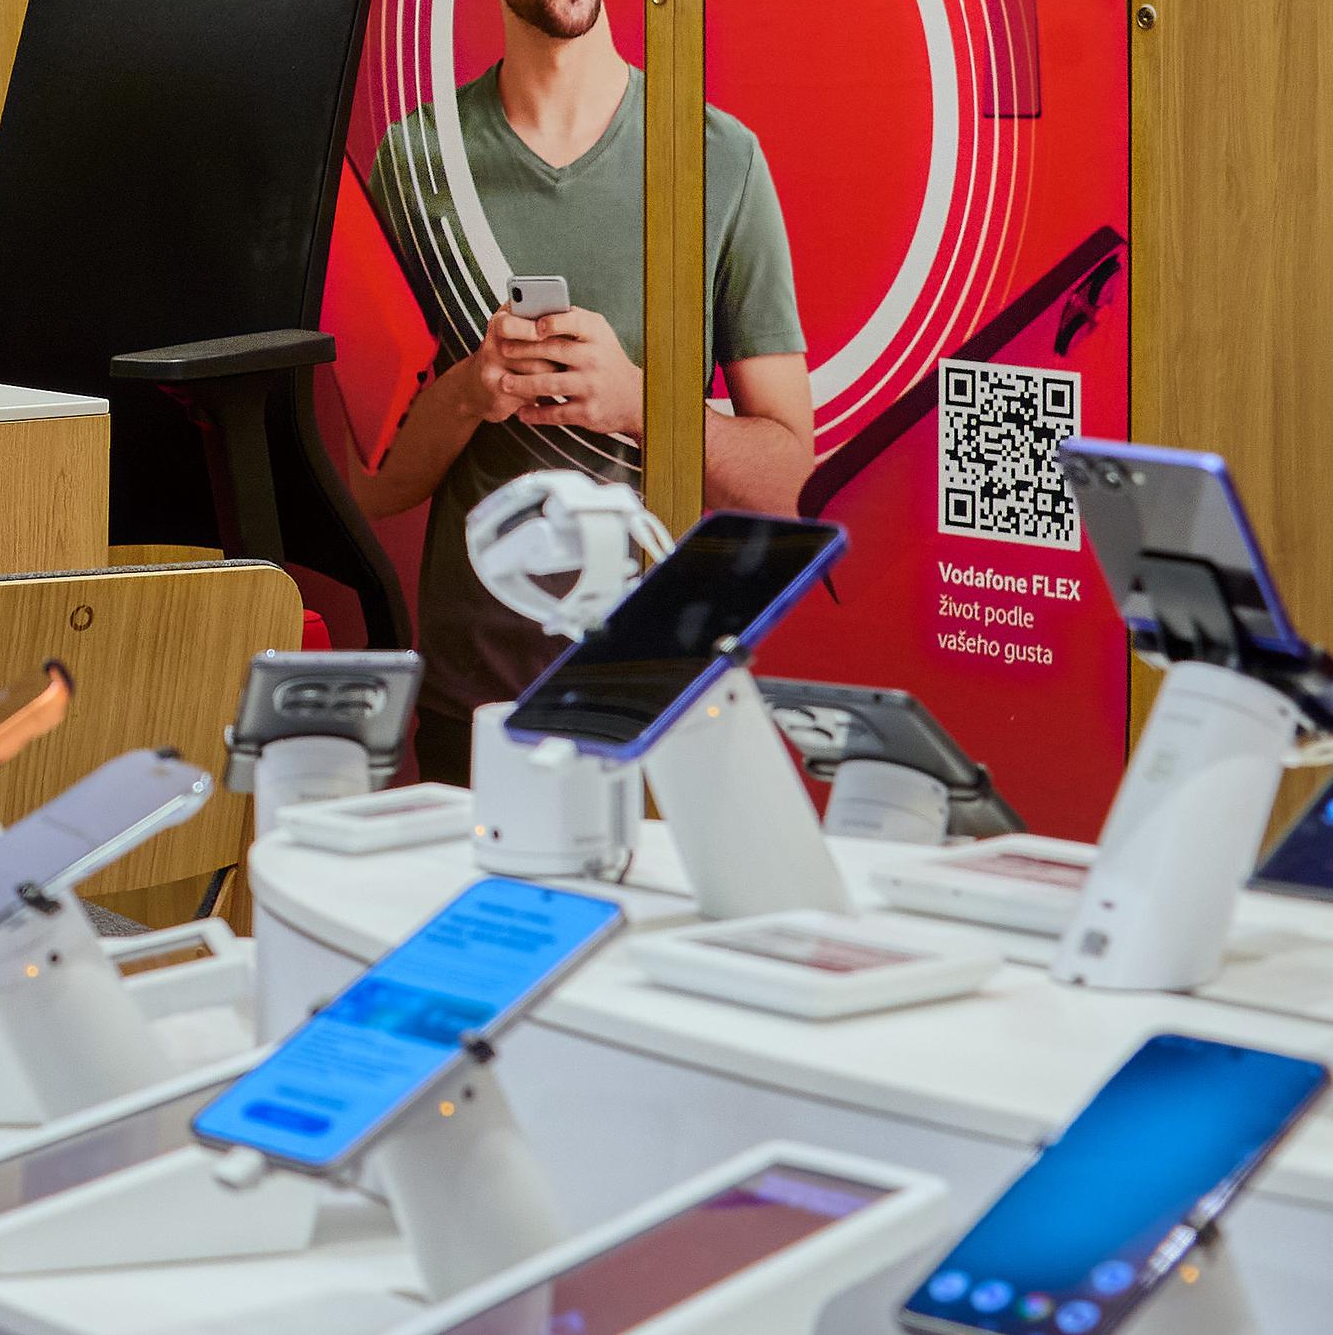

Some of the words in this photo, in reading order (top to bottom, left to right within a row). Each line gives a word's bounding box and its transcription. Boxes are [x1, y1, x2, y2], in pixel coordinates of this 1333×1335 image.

[938, 561, 1028, 596] Vodafone
[1032, 574, 1082, 601] FLEX
[938, 594, 981, 621] život
[984, 605, 1035, 629] podle
[937, 629, 1001, 657] vašeho
[1004, 641, 1054, 665] gusta
